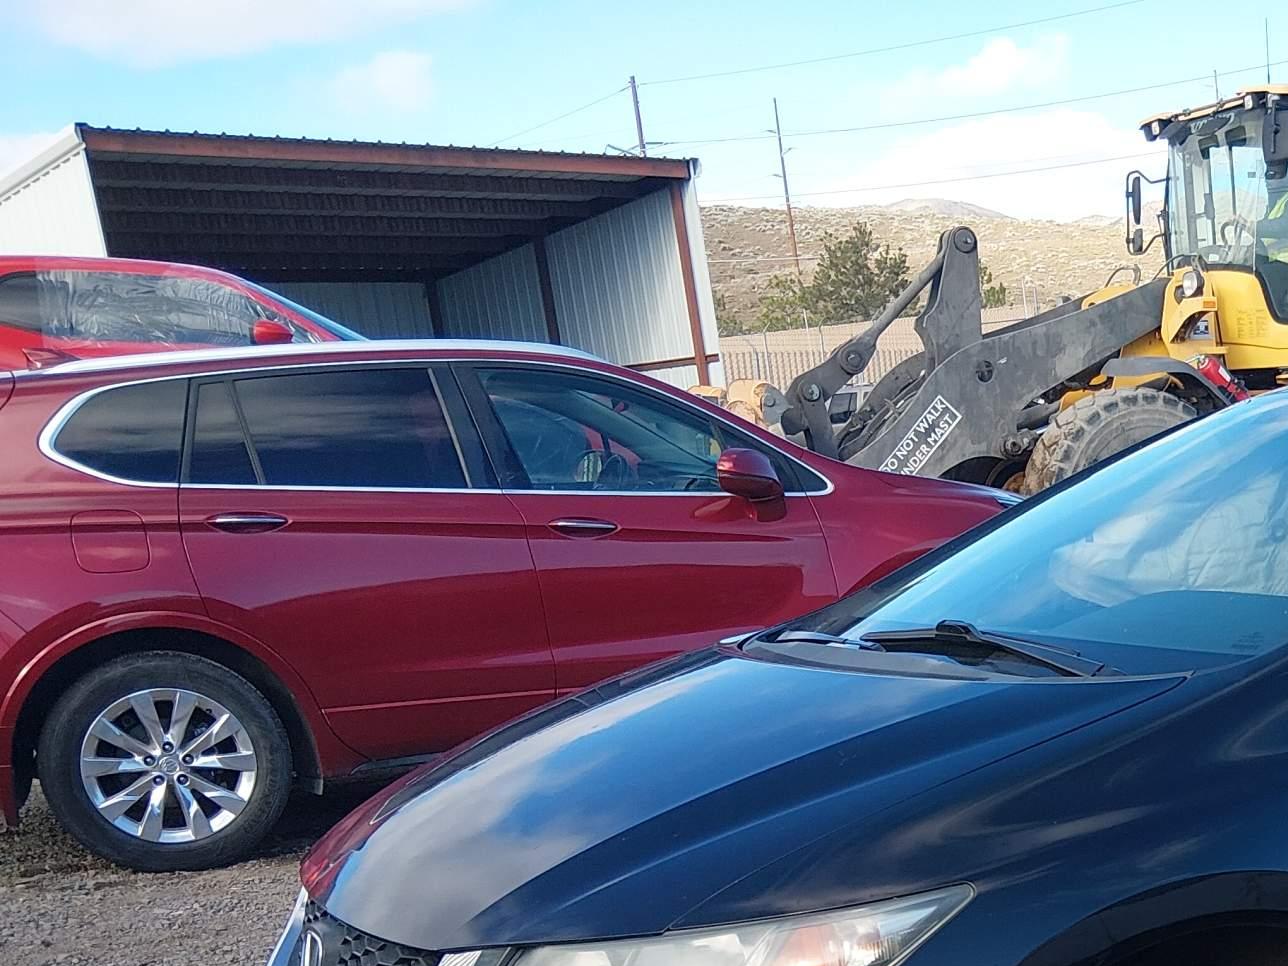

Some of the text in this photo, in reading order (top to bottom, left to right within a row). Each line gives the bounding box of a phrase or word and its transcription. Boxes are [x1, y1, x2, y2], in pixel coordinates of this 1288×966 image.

[895, 431, 919, 460] NOT
[915, 400, 947, 433] WALK
[900, 413, 954, 475] NDER MAST
